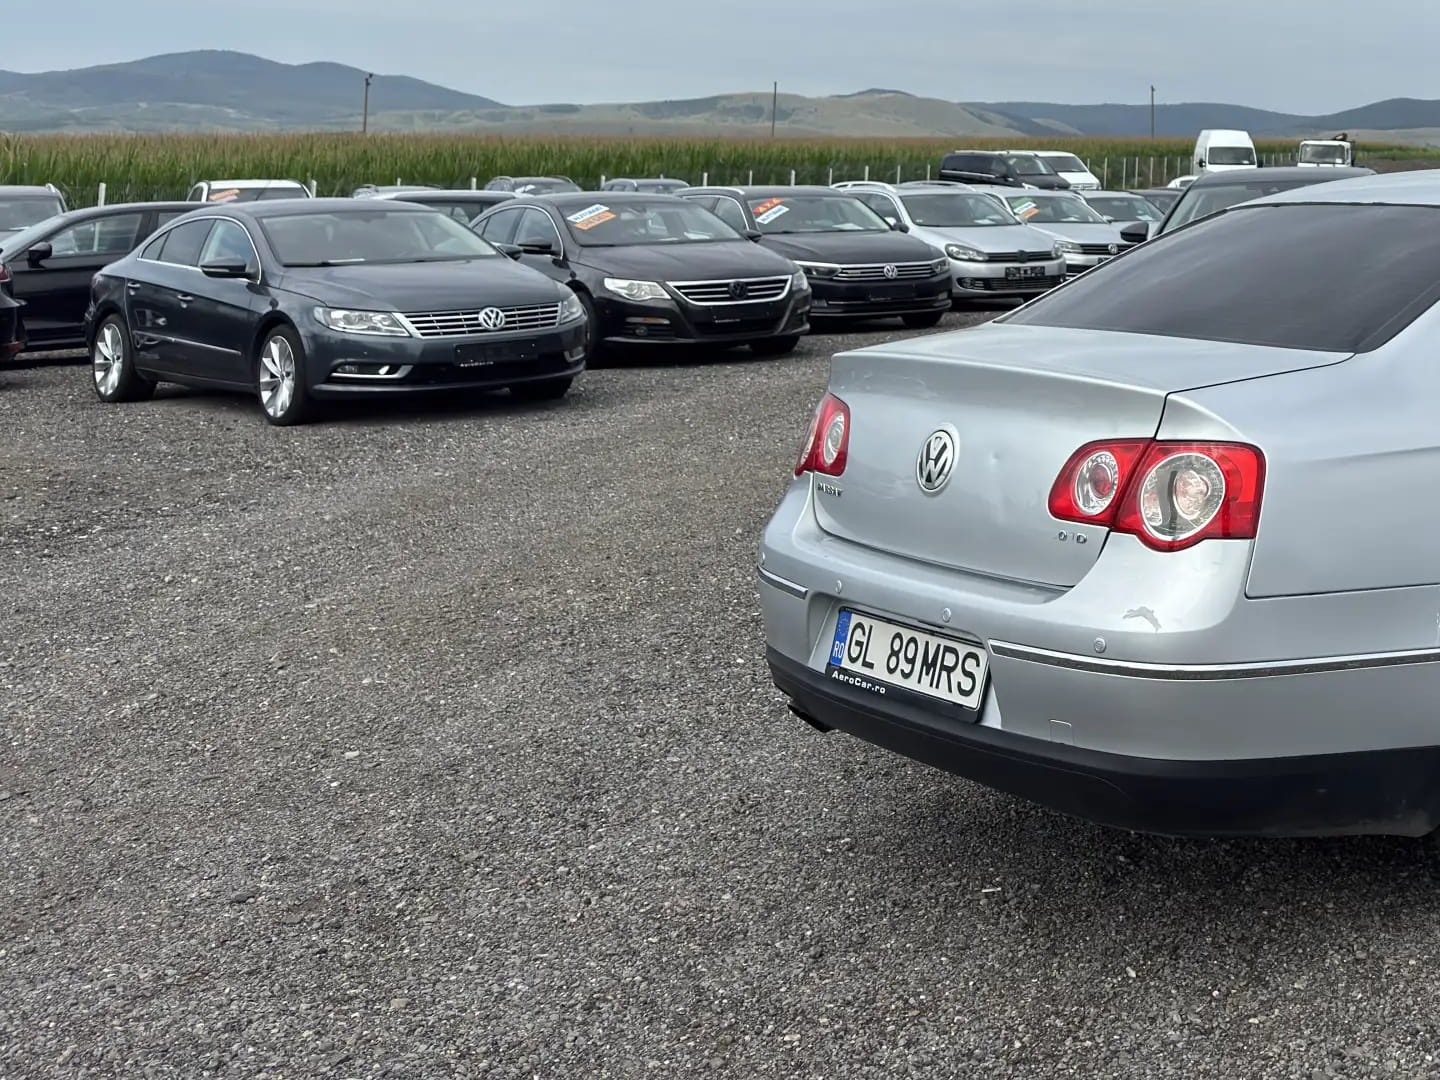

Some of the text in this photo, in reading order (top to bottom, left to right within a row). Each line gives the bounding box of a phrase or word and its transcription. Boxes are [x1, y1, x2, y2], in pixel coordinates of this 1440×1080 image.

[832, 640, 845, 659] RO
[847, 622, 981, 697] GL 89 MRS
[831, 669, 887, 695] AeroCar.ro
